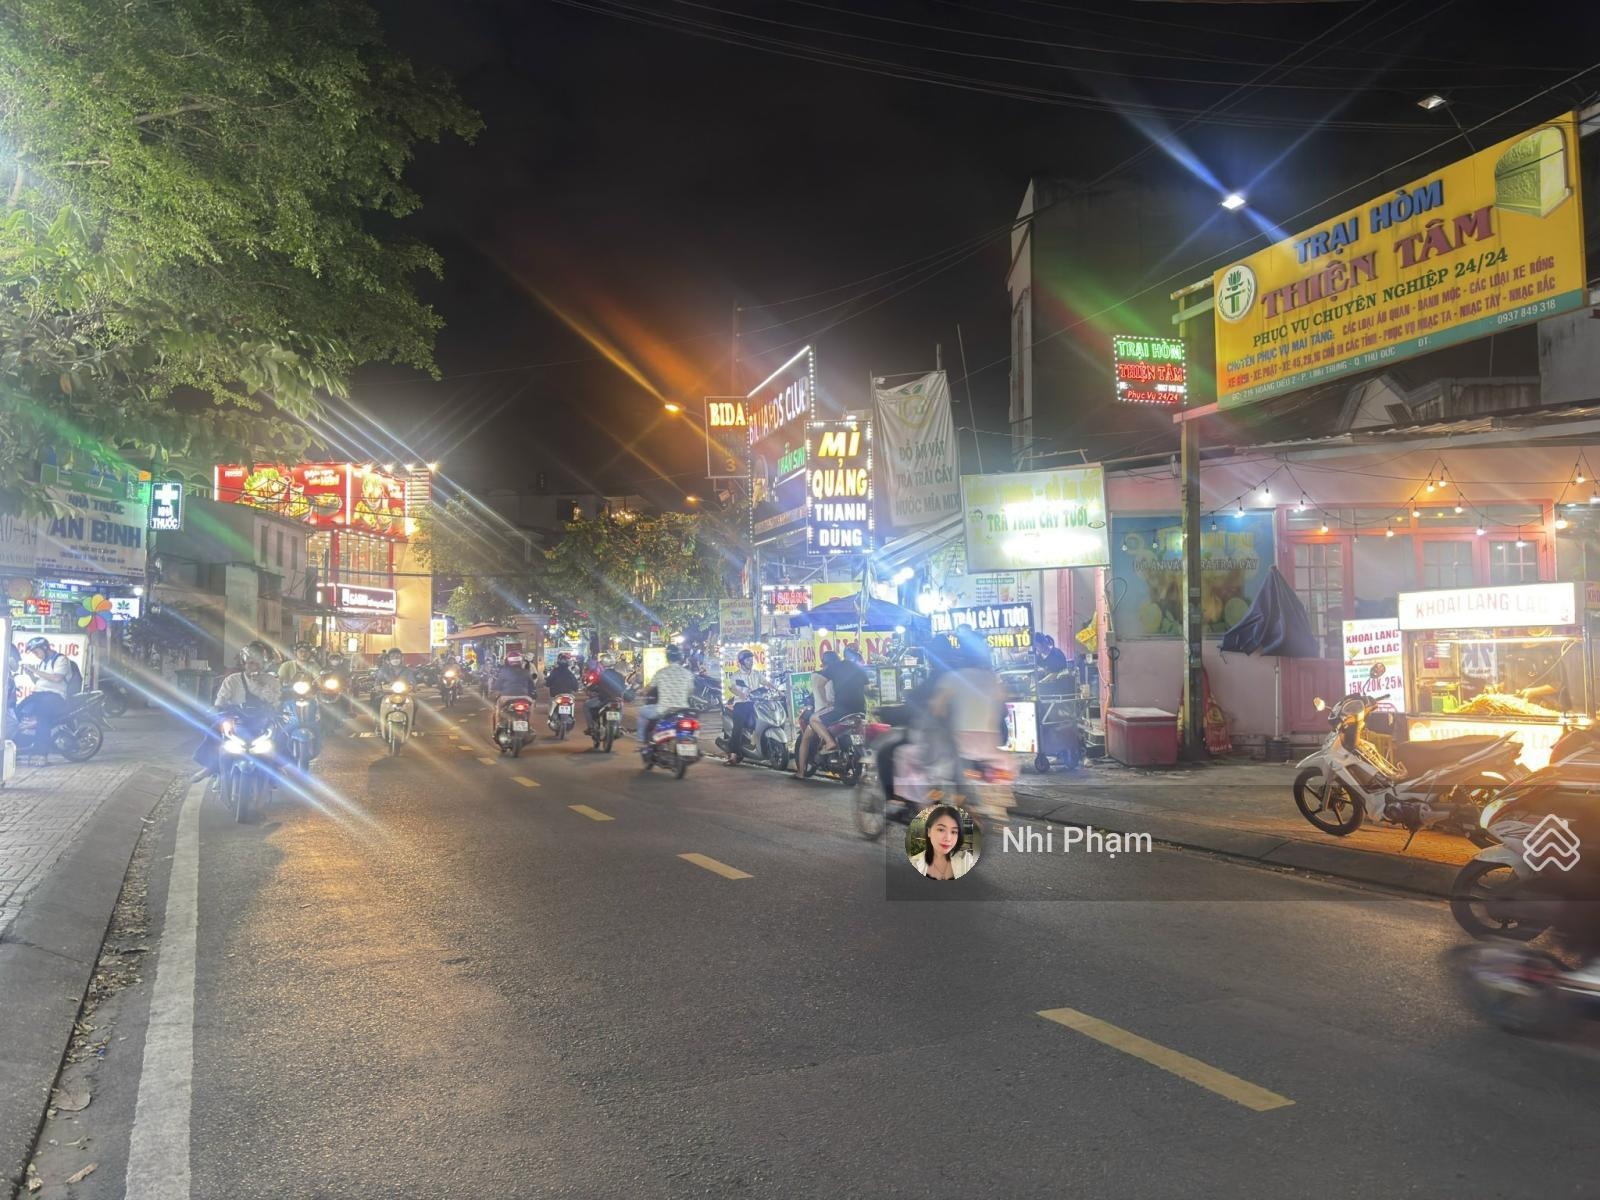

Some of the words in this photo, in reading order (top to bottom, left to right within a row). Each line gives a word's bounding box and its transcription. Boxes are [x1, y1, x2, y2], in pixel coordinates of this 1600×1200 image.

[1292, 217, 1359, 264] TRẠI
[1370, 179, 1444, 233] HÒM
[1261, 250, 1378, 320] THIỆN
[1394, 205, 1495, 269] TÂM
[1253, 324, 1288, 347] PHỤC
[1292, 317, 1309, 335] VỤ
[1312, 290, 1377, 324] CHUYÊN
[1383, 268, 1449, 303] NGHIỆP
[1454, 247, 1508, 278] 24/24
[1441, 309, 1452, 322] TA
[1459, 300, 1482, 319] NHẠC
[1508, 284, 1534, 304] NHẠC
[1292, 340, 1307, 354] MAI
[1342, 319, 1357, 336] CÁC
[1469, 276, 1486, 294] CÁC
[1513, 266, 1525, 279] XE
[1497, 309, 1518, 324] 0937
[1520, 305, 1538, 318] 849
[1539, 299, 1557, 312] 318
[1117, 341, 1149, 359] TRẠI
[1152, 340, 1182, 360] HÒM
[1119, 361, 1156, 382] THIỆN
[1158, 363, 1184, 382] TÂM
[1158, 392, 1178, 401] 24/24
[709, 402, 746, 426] BIDA
[818, 425, 861, 457] MÌ
[811, 458, 868, 500] QUẢNG
[935, 463, 953, 484] CÂY
[815, 503, 867, 522] THANH
[51, 517, 84, 541] AN
[91, 513, 141, 548] BÌNH
[819, 524, 863, 547] DŨNG
[978, 606, 1002, 629] CÂY
[1416, 595, 1462, 619] KHOAI
[1467, 592, 1510, 613] LANG
[987, 634, 1013, 648] SINH
[1016, 630, 1031, 647] TỐ
[1346, 633, 1373, 644] KHOAI
[1375, 629, 1399, 640] LANG
